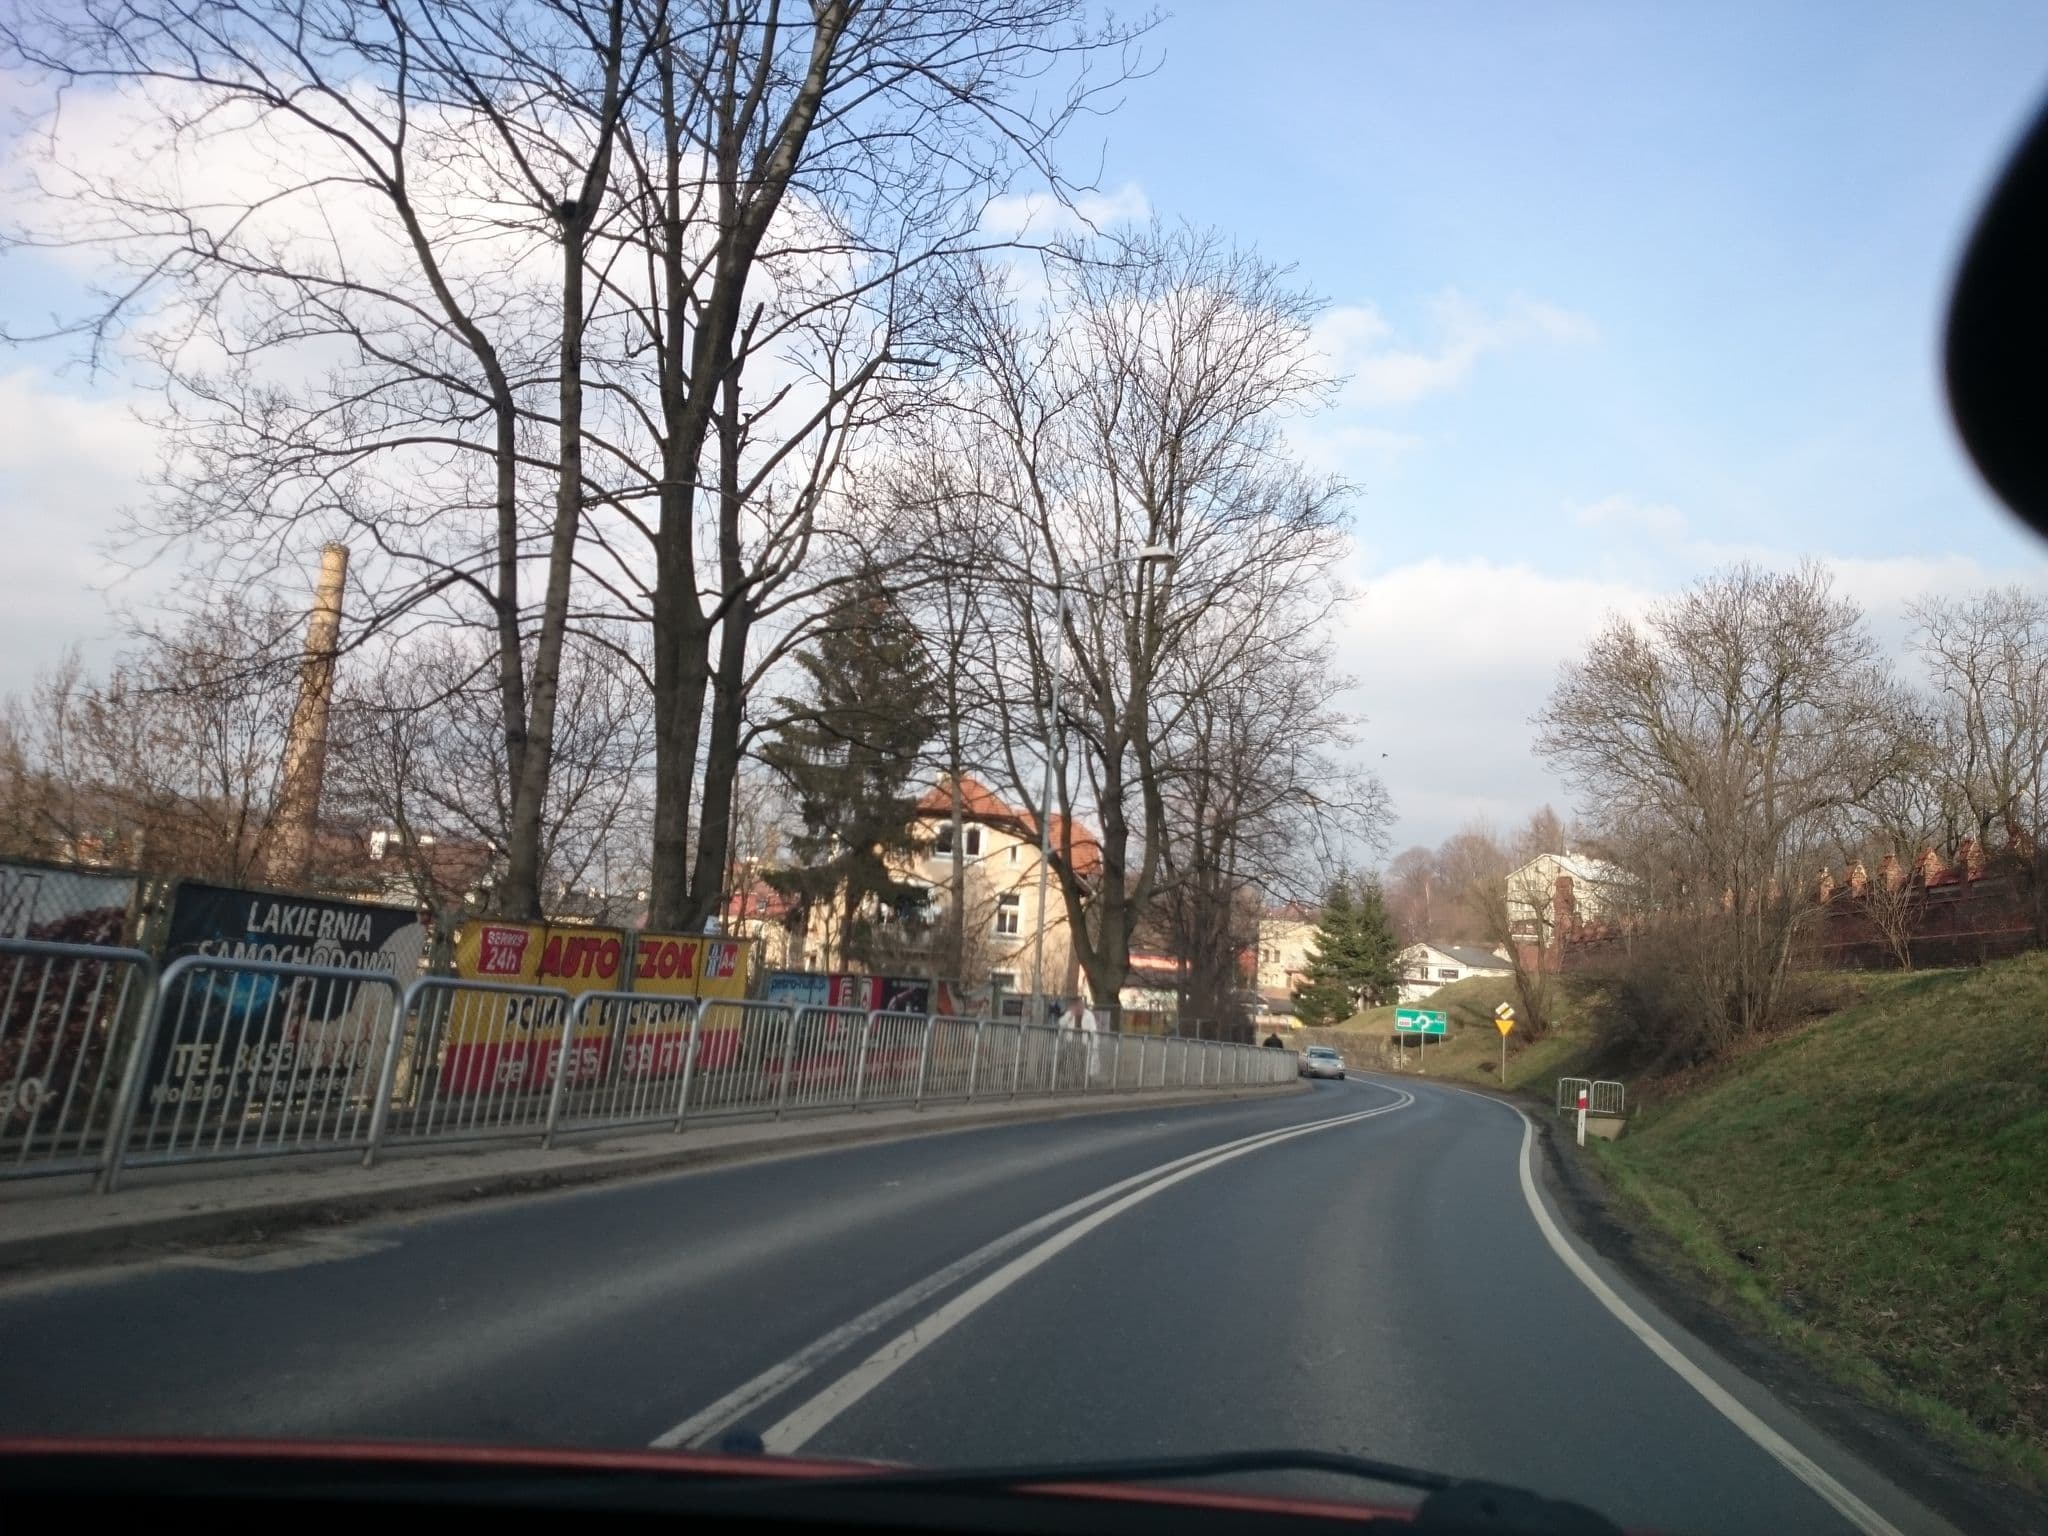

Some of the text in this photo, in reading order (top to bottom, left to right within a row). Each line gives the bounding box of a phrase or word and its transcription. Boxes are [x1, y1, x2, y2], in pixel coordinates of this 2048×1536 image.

[246, 900, 373, 943] LAKIERNIA
[486, 947, 518, 971] 24h
[536, 935, 699, 979] AUTO ZOK
[506, 995, 692, 1029] POMC DOGOW
